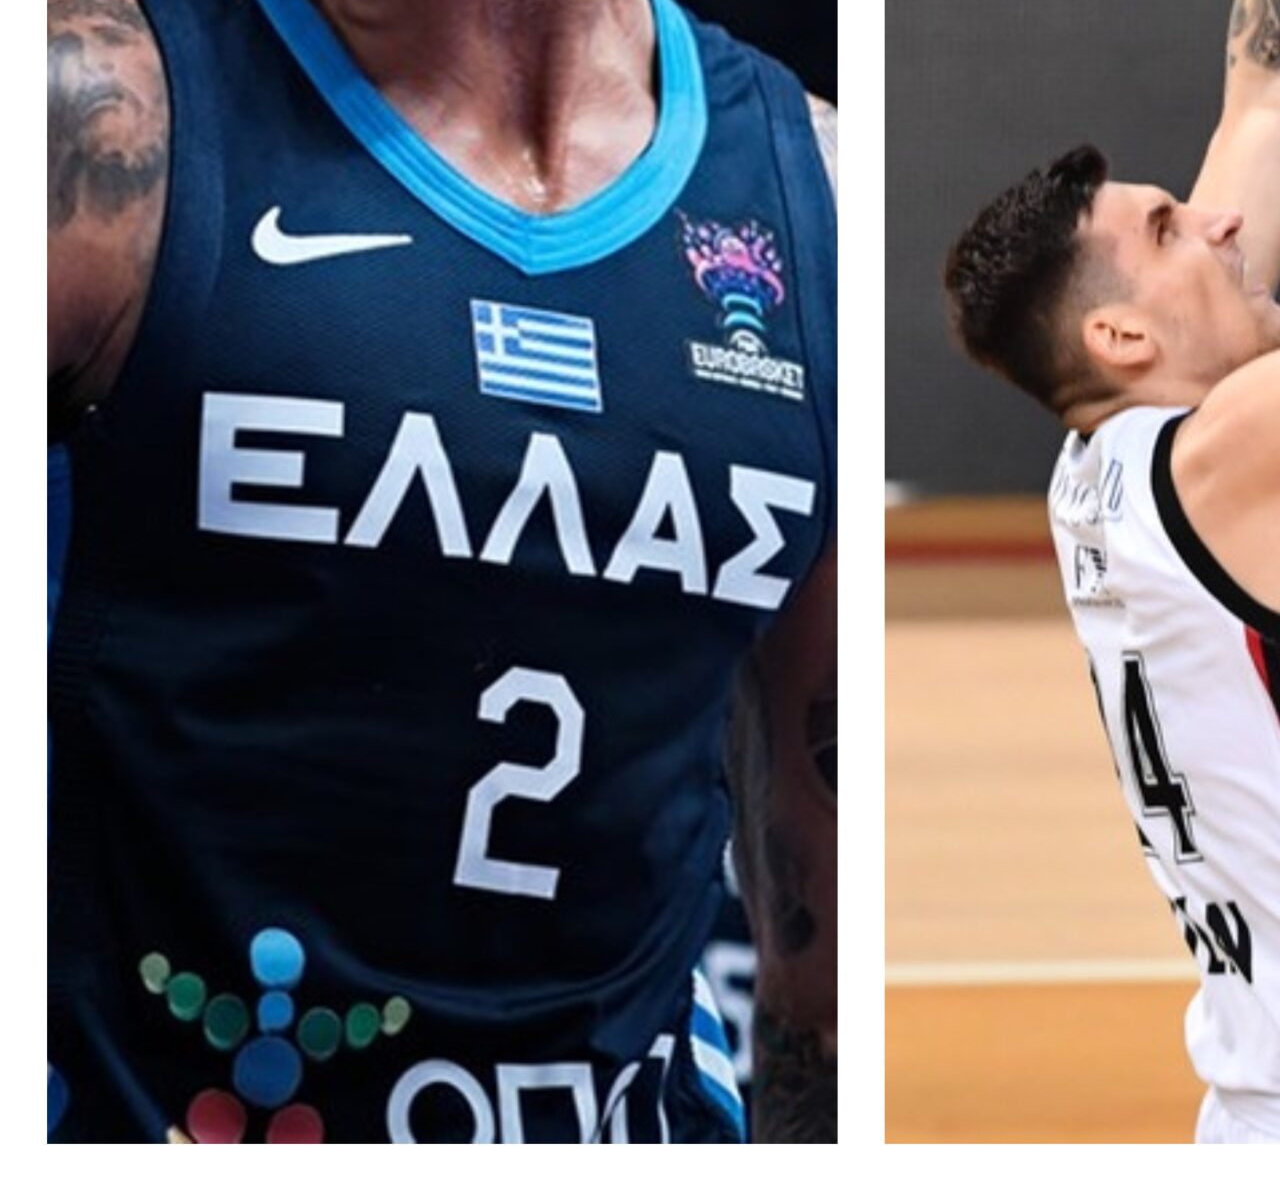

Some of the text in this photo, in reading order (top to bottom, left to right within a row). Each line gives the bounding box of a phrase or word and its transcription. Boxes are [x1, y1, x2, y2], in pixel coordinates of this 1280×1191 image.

[197, 390, 816, 610] ΕΛΛΑΣ
[453, 666, 586, 900] 2
[1090, 649, 1204, 866] 4
